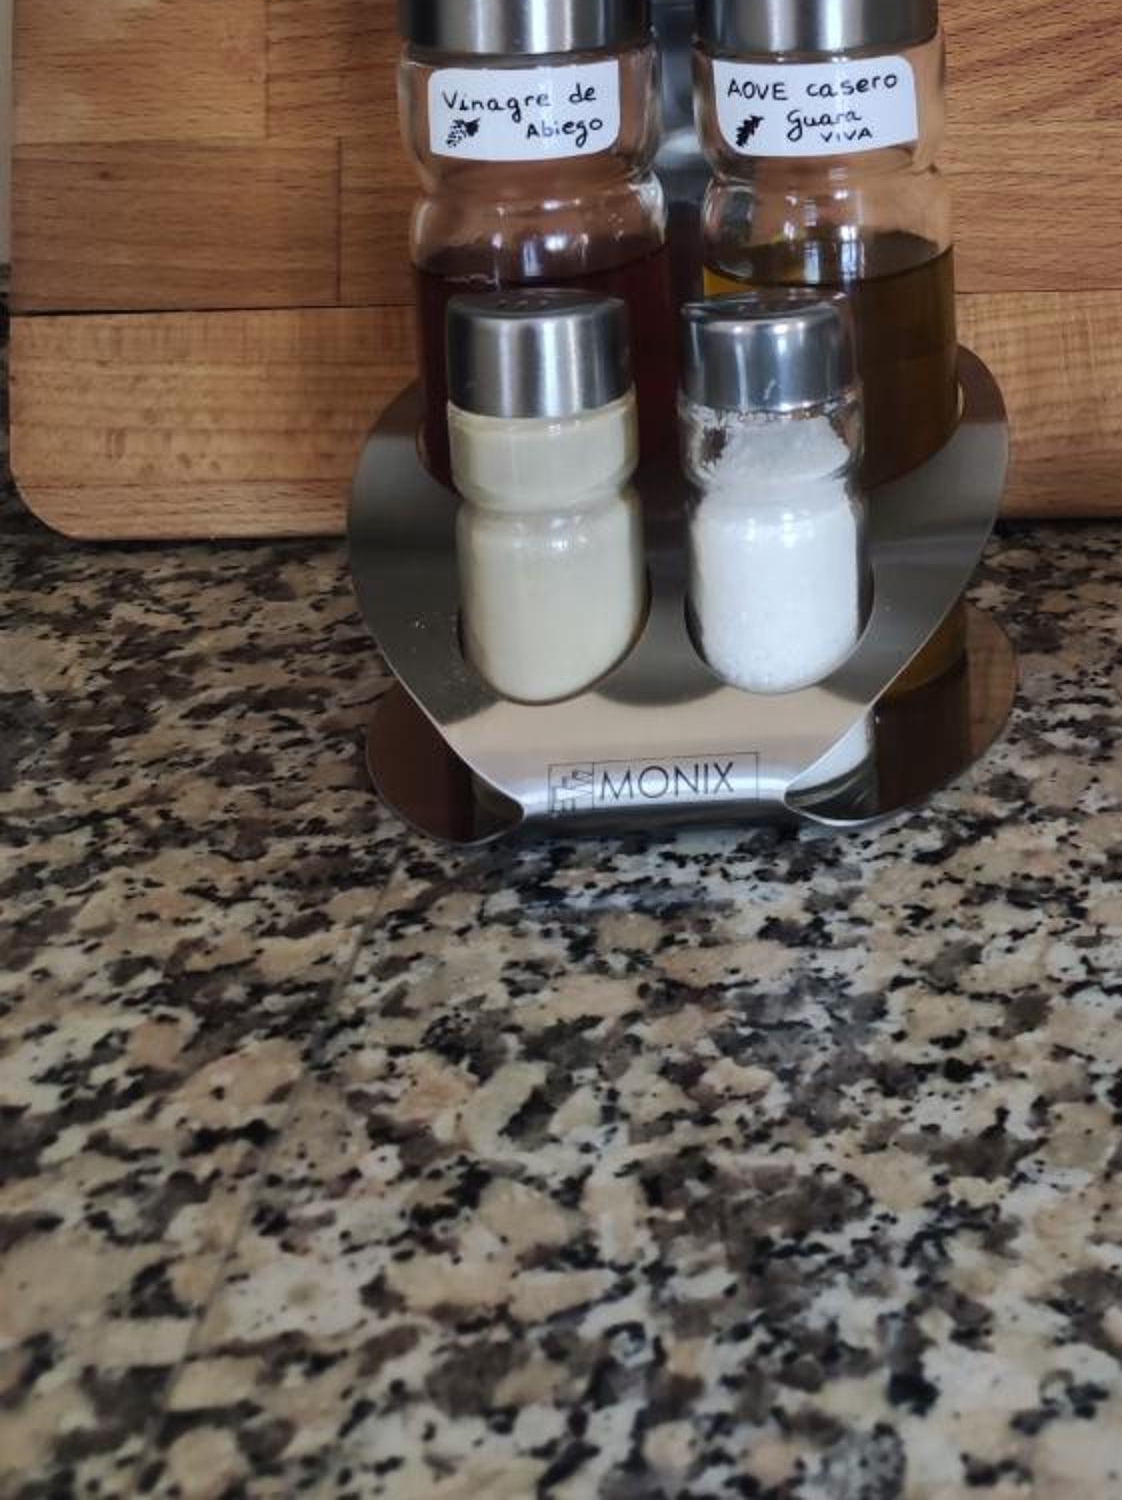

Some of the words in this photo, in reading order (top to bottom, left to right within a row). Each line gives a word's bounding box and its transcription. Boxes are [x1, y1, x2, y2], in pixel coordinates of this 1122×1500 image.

[442, 89, 550, 124] Vinagre
[568, 82, 597, 104] de
[727, 78, 788, 101] AOVE
[806, 73, 898, 98] casero
[526, 117, 603, 148] Abiego
[600, 761, 734, 800] MONIX
